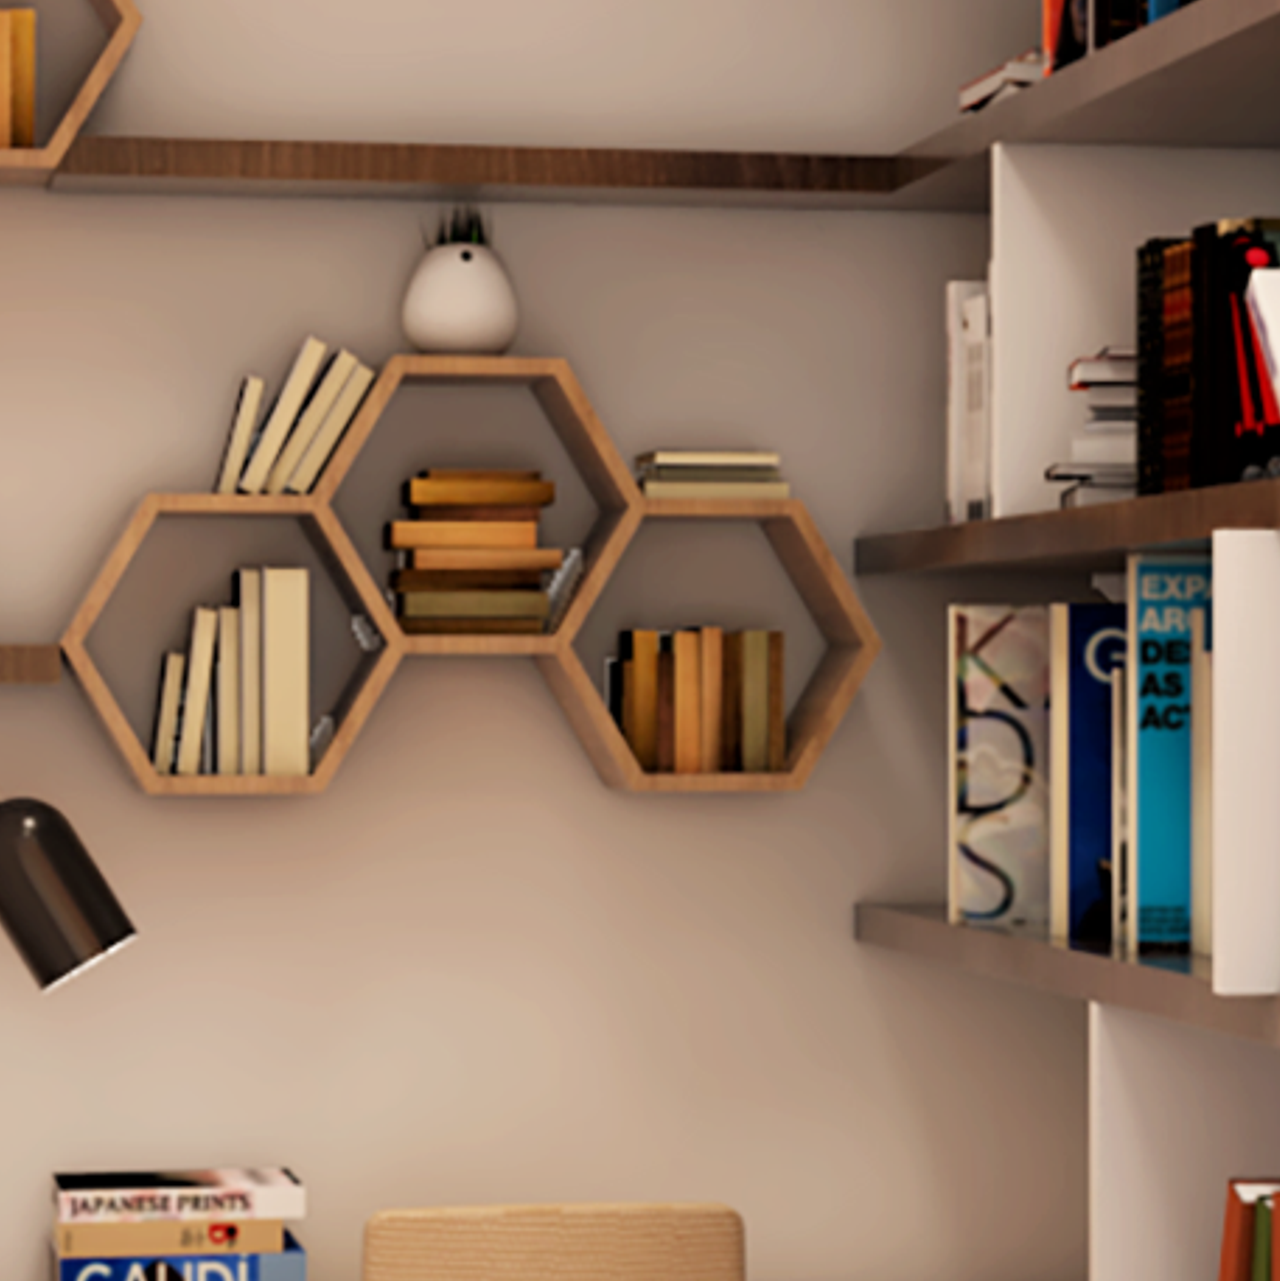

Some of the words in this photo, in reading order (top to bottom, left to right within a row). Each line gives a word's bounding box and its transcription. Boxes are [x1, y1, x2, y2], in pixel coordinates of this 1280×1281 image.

[1140, 607, 1190, 633] AR
[1141, 639, 1190, 666] DE
[1140, 672, 1182, 699] AS
[1140, 704, 1190, 731] AC
[70, 1194, 169, 1217] JAPANESE
[177, 1193, 253, 1213] PRINTS
